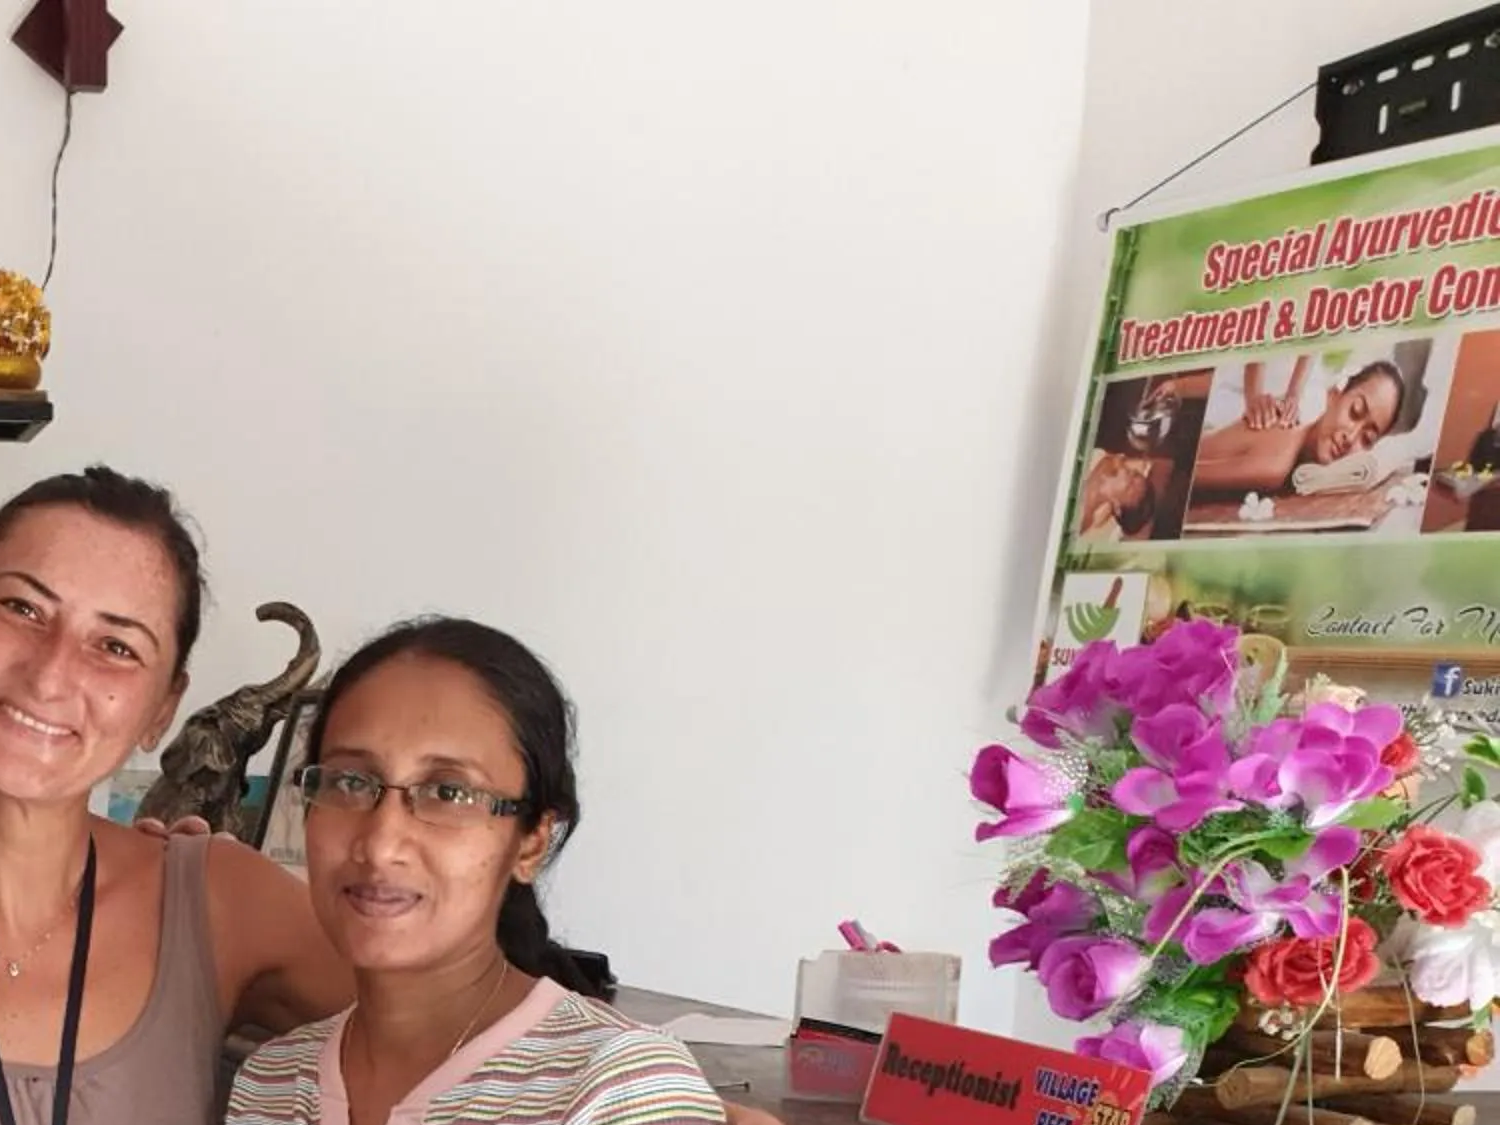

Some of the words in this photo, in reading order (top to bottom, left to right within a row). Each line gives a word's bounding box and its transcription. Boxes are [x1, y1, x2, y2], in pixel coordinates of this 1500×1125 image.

[1203, 222, 1327, 291] Special
[1119, 300, 1271, 362] Treatment
[1273, 299, 1296, 342] &
[1303, 277, 1423, 336] Doctor
[1427, 263, 1500, 320] Con
[1307, 605, 1396, 636] Contact
[1403, 606, 1446, 635] For
[881, 1041, 1023, 1111] Receptionist
[1035, 1067, 1100, 1107] VILLAGE
